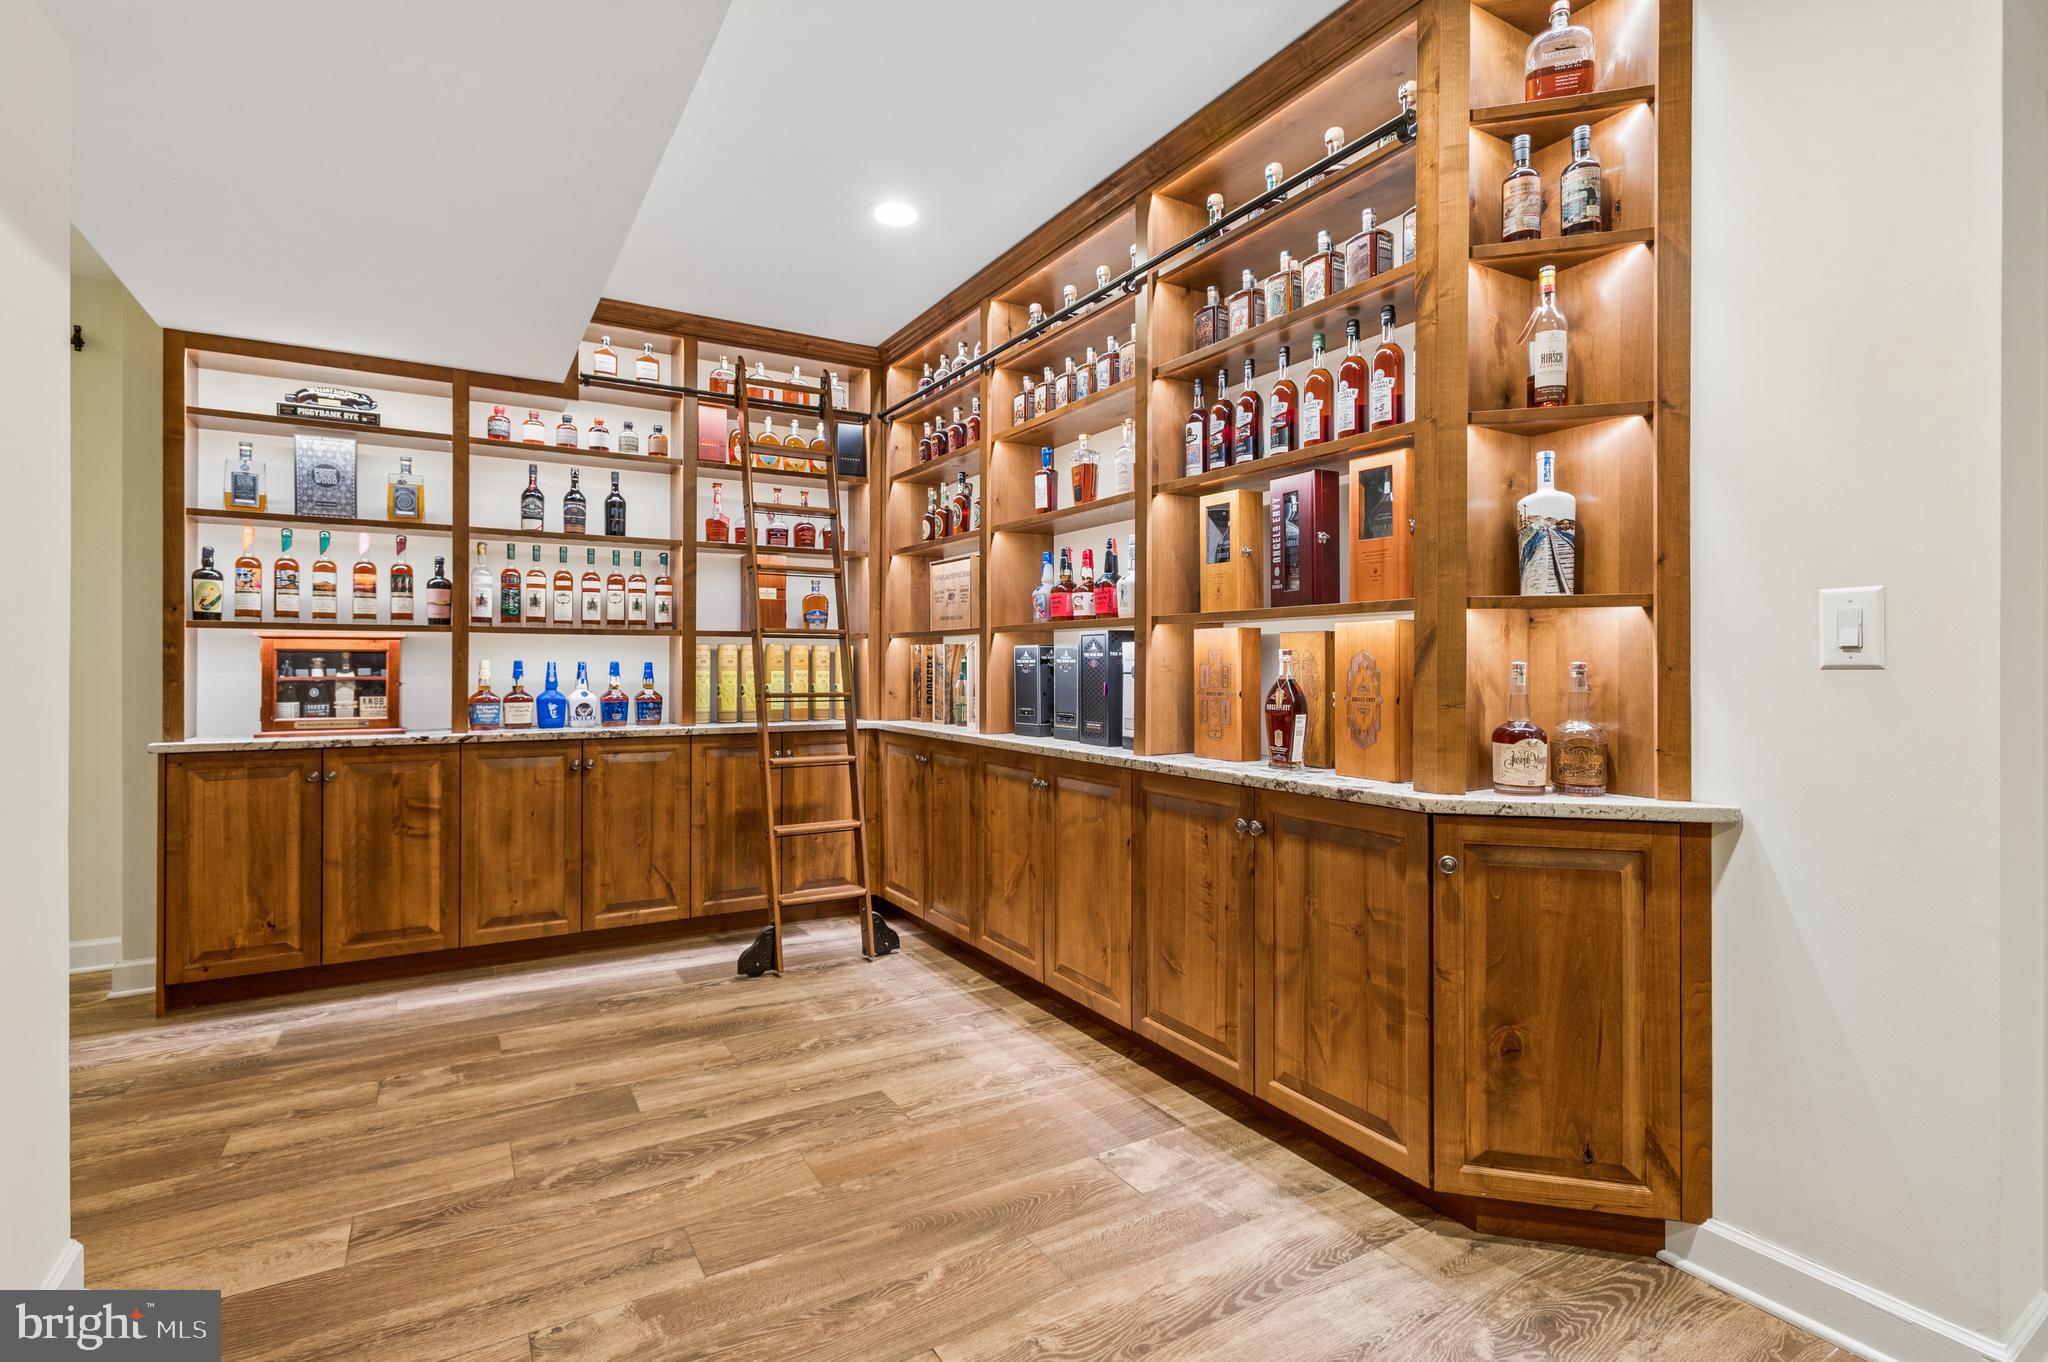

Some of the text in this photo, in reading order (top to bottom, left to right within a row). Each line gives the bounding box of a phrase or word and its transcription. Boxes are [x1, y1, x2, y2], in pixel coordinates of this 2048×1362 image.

[1541, 352, 1563, 364] HIRSCH
[297, 407, 342, 418] PIGGYBANK
[343, 412, 359, 421] RYE
[1272, 498, 1281, 523] ENVY
[362, 697, 385, 706] KNOB
